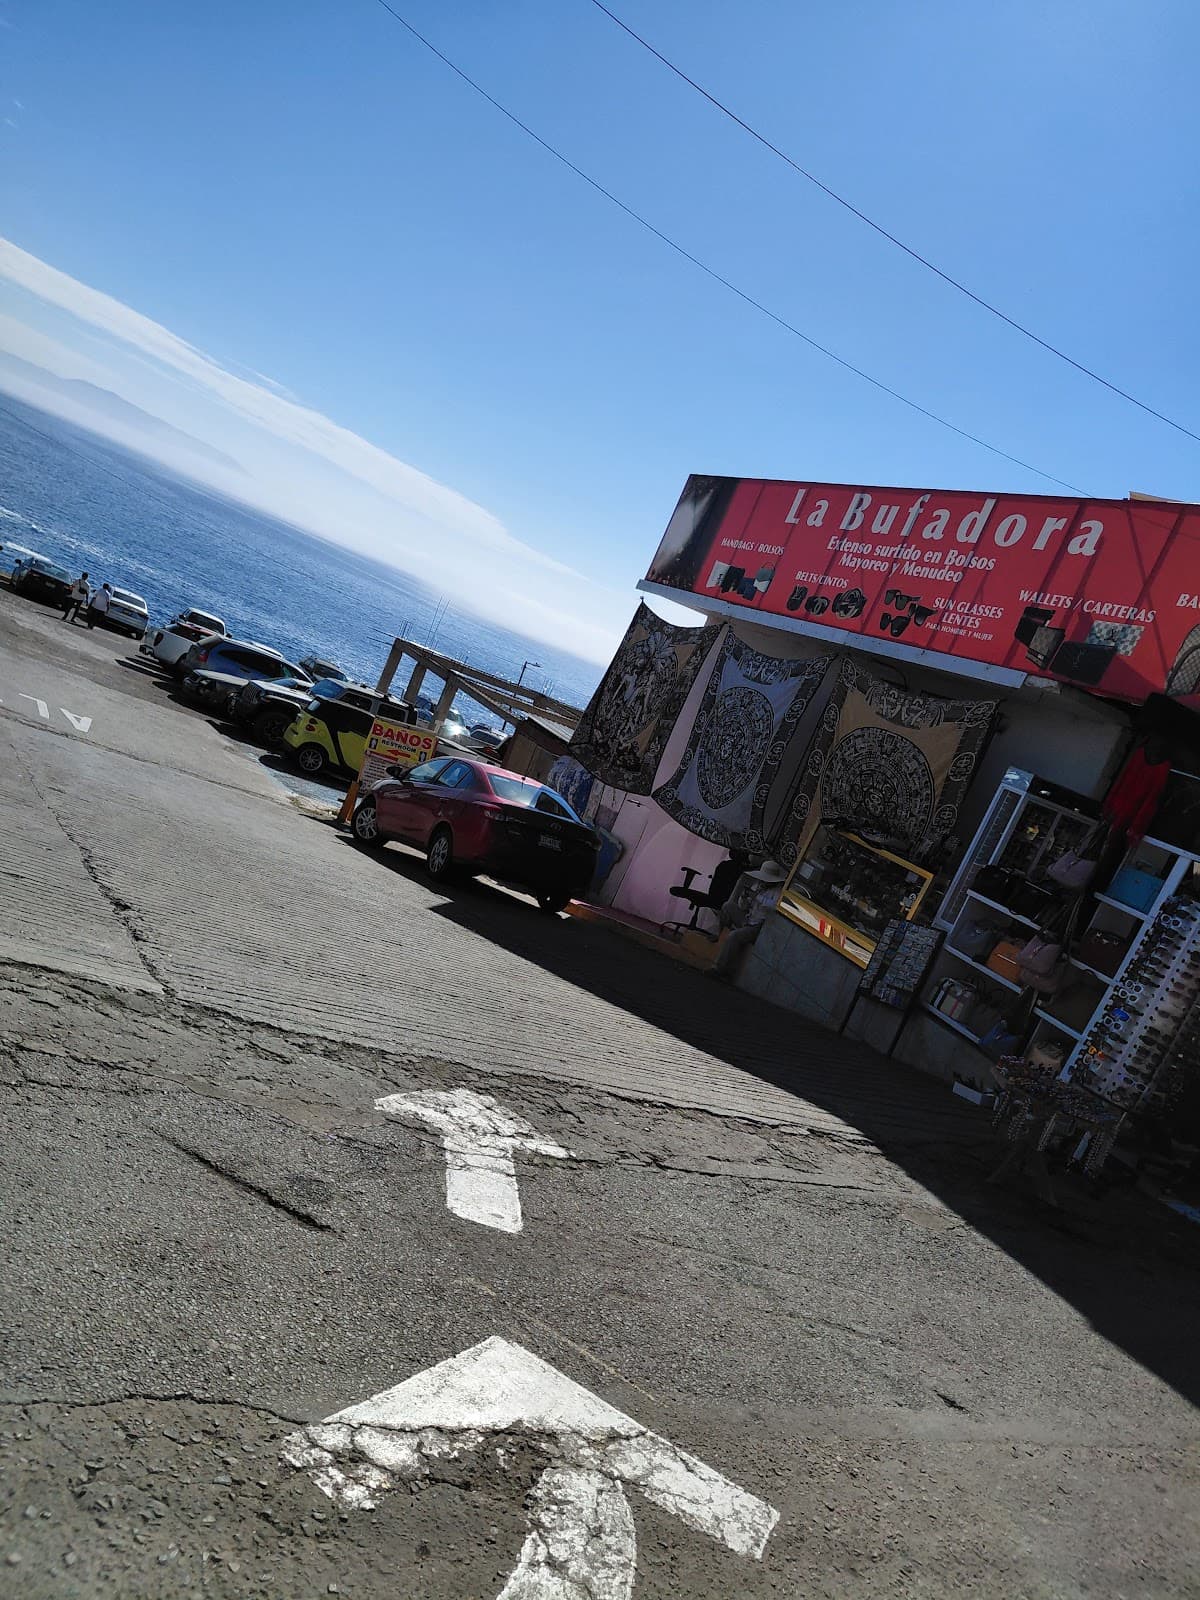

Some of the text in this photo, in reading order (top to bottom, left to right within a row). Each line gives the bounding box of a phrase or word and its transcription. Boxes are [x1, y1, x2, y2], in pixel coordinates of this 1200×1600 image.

[785, 488, 1104, 556] La Bufadora
[720, 537, 755, 551] HANDBAGS
[759, 543, 785, 556] BOLSOS
[827, 535, 997, 571] Extenso surtido en Bolsos
[838, 552, 964, 583] Mayoreo y Menudeo
[795, 570, 849, 589] BELTS/CINTOS
[933, 597, 1004, 619] SUN GLASSES
[1019, 589, 1074, 609] WALLETS
[1083, 599, 1157, 623] CARTERAS
[1175, 593, 1200, 609] BA
[942, 613, 982, 629] LENTES
[372, 724, 432, 749] BAÑOS
[381, 739, 417, 753] RESTROOM
